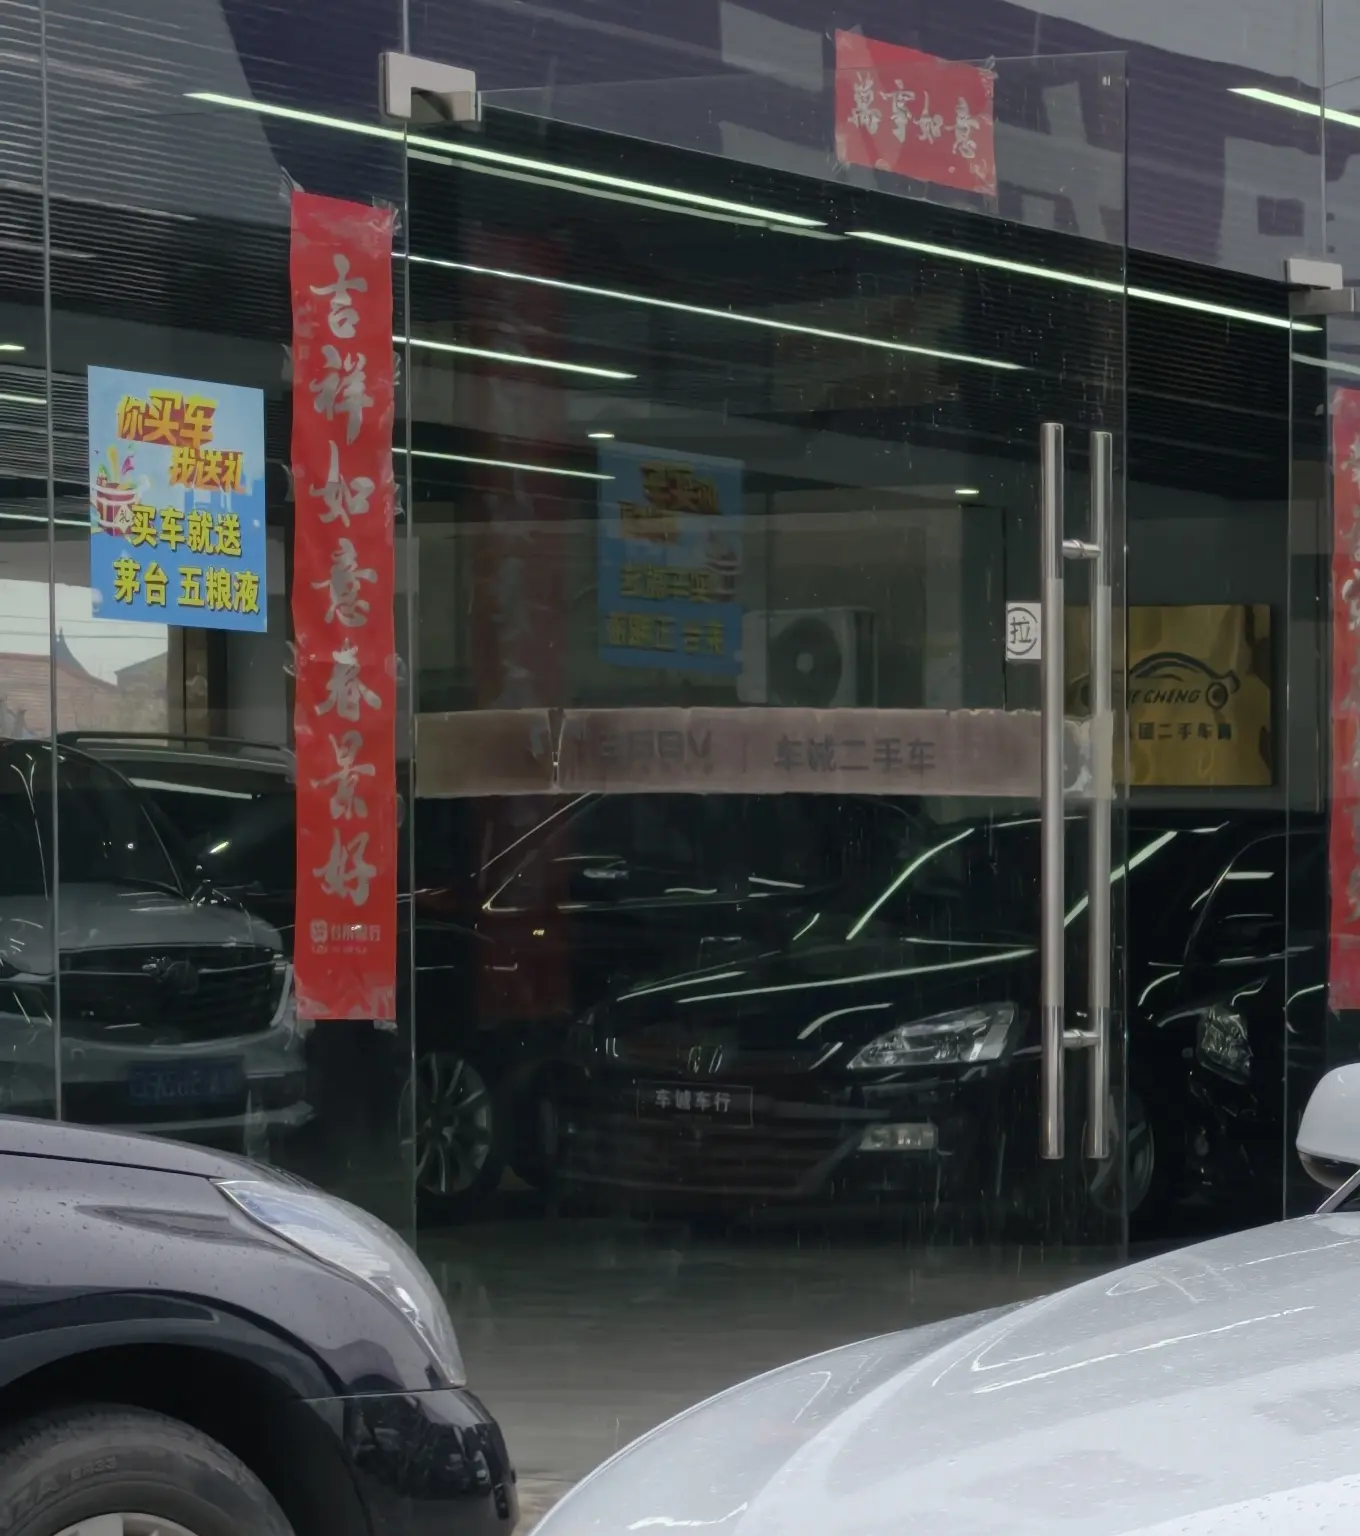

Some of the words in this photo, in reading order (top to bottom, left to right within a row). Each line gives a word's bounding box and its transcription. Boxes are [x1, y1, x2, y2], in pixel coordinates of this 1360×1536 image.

[116, 389, 219, 447] 你买车
[170, 446, 247, 495] 我送礼
[130, 503, 243, 558] 买车就送
[113, 556, 168, 607] 茅台
[177, 566, 261, 615] 五粮液
[310, 253, 382, 907] 吉祥如意春景好
[1010, 616, 1032, 644] 拉
